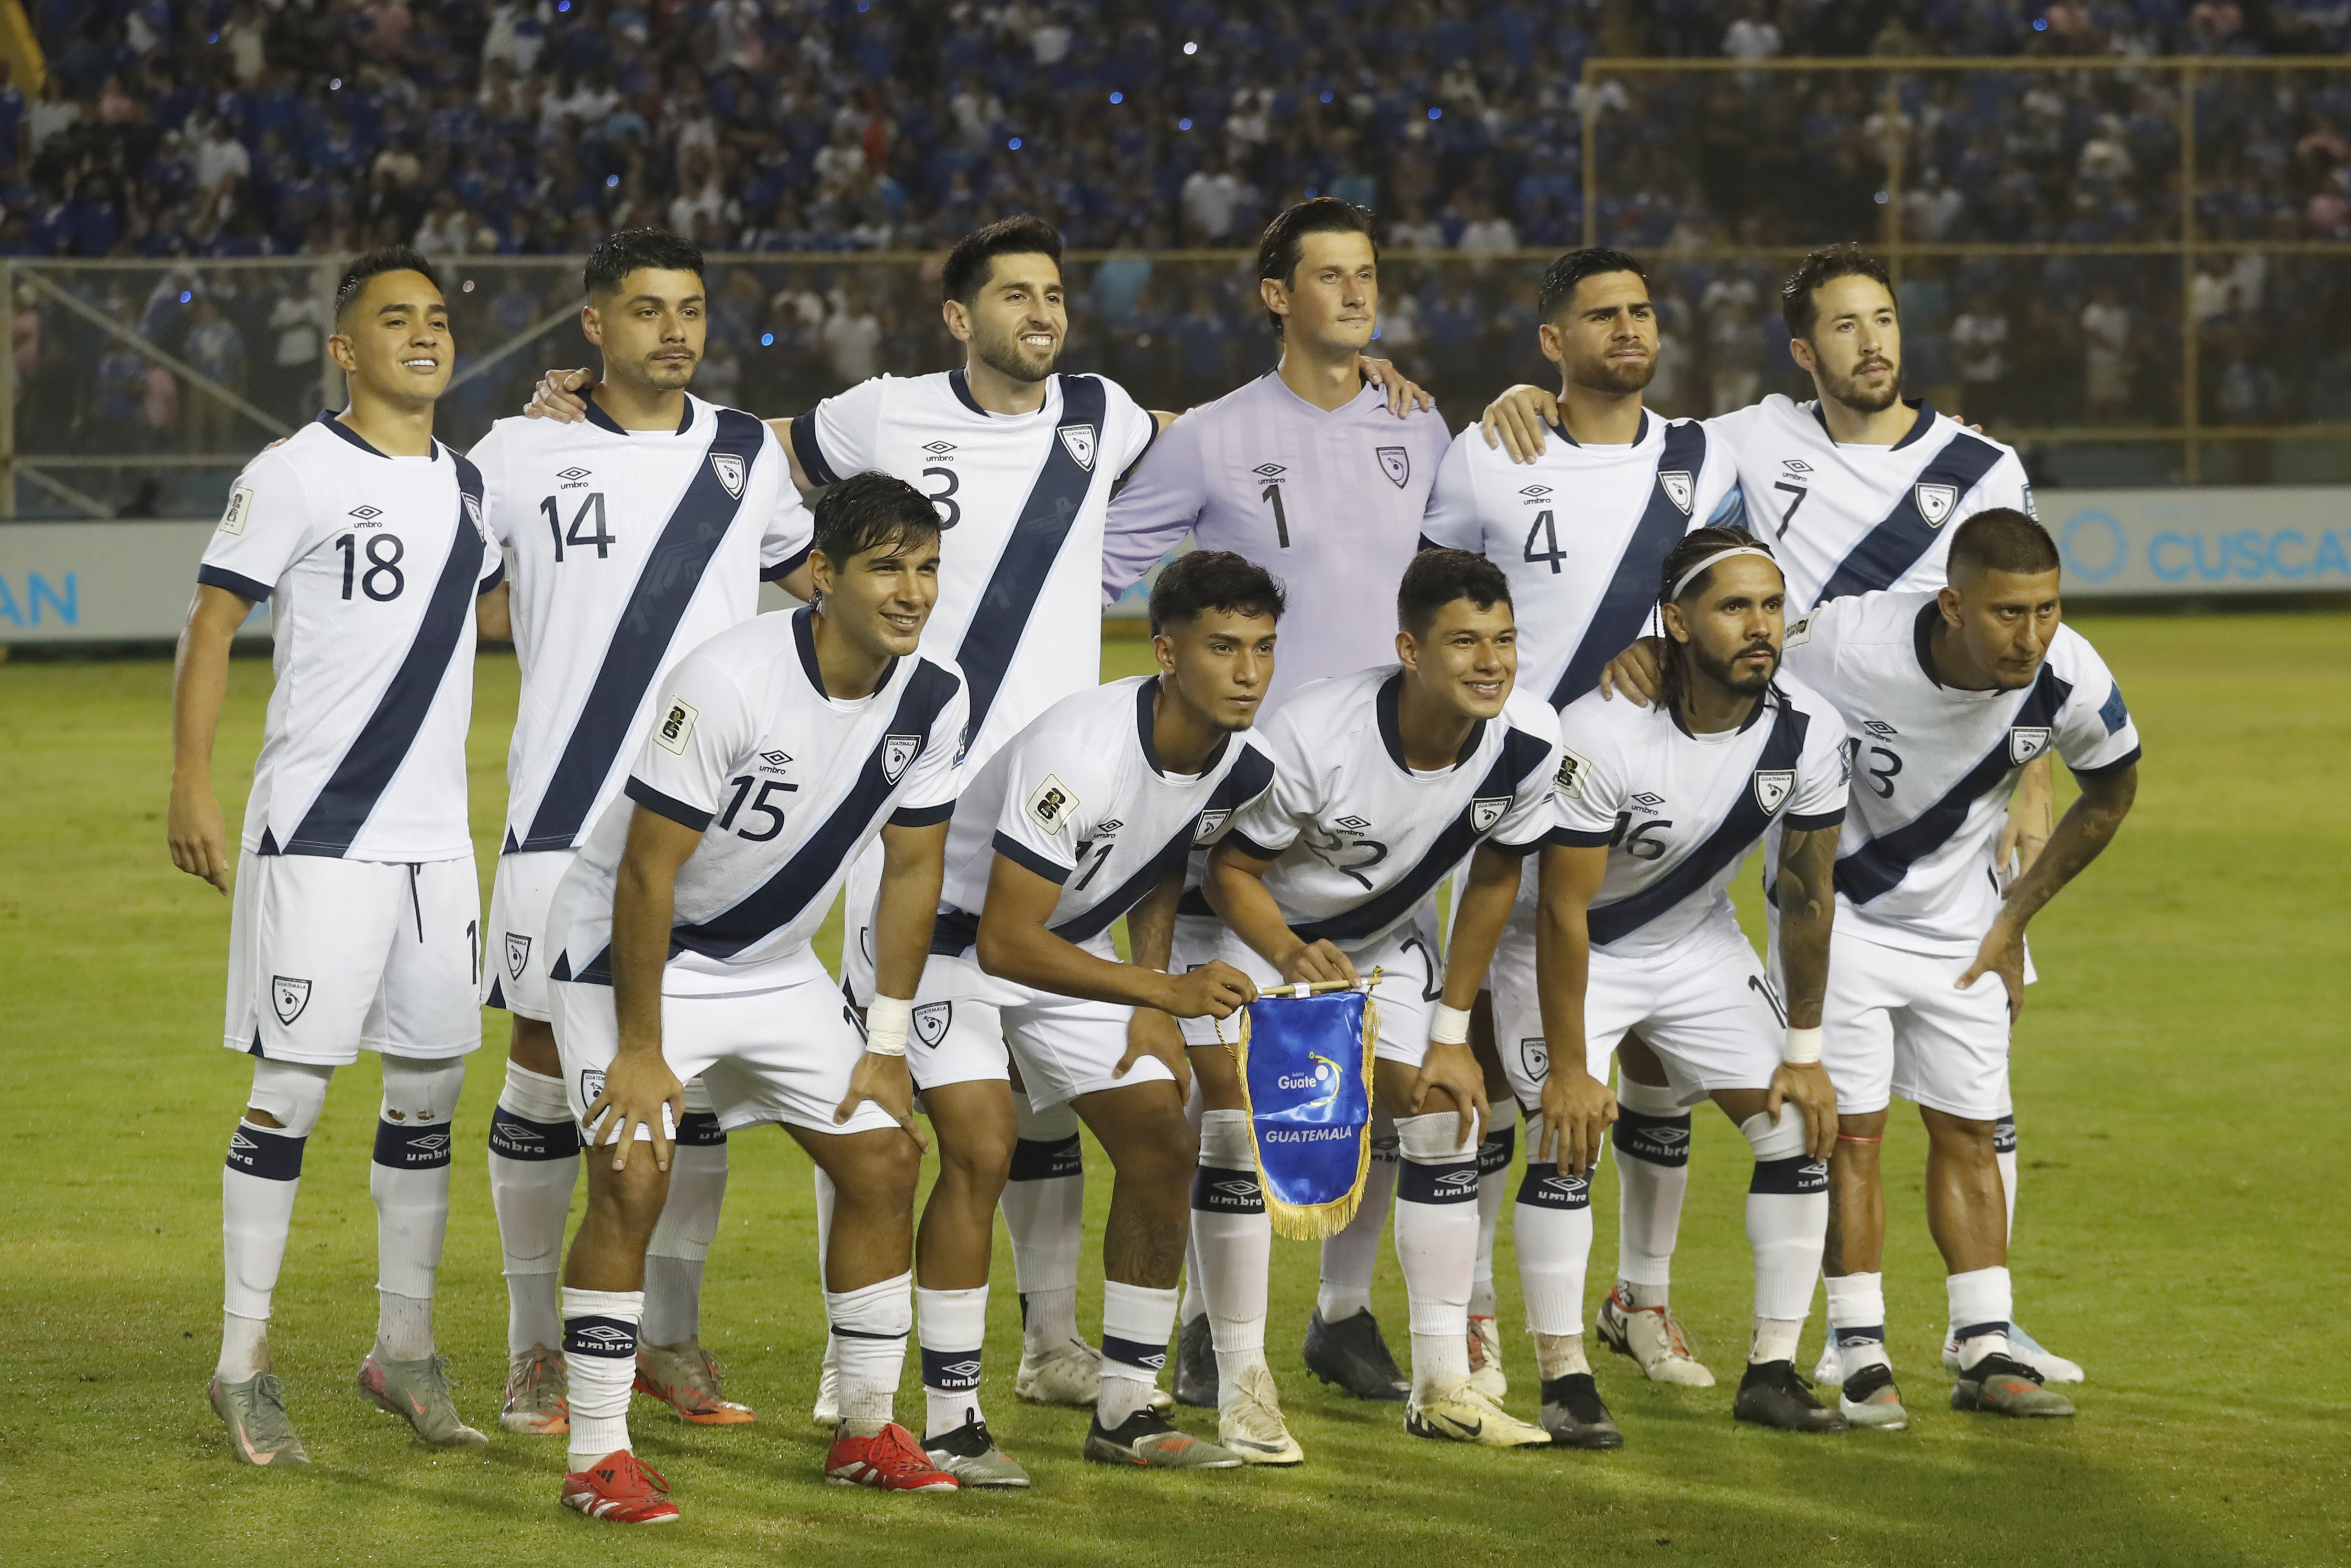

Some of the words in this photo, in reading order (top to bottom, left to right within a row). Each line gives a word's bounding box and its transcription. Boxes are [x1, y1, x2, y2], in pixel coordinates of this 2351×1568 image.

[1258, 476, 1285, 485] umbro
[1782, 471, 1807, 483] umbro
[561, 481, 589, 489] umbro
[923, 467, 960, 531] 3
[1523, 497, 1551, 505] umbro
[1262, 484, 1289, 548] 1
[1774, 481, 1807, 542] 7
[354, 521, 383, 529] umbro
[540, 493, 616, 562] 14
[1523, 510, 1567, 574] 4
[2148, 528, 2351, 582] CUSCA
[336, 533, 404, 602] 18
[1865, 729, 1892, 743] umbro
[760, 765, 786, 775] umbro
[719, 775, 798, 842] 15
[1631, 804, 1658, 816] umbro
[1336, 829, 1365, 837] umbro
[1609, 812, 1673, 861] 16
[277, 981, 306, 989] GUATEMALA
[1748, 975, 1787, 1029] 1
[917, 1006, 947, 1016] GUATEMALA
[844, 1005, 868, 1046] 1
[1278, 1075, 1317, 1090] Guate
[1265, 1125, 1352, 1143] GUATEMALA
[493, 1134, 545, 1153] umbro
[228, 1148, 254, 1165] bro
[1476, 1154, 1505, 1167] bro
[1433, 1184, 1478, 1197] umbr
[1538, 1191, 1587, 1202] umbro
[1209, 1195, 1263, 1206] umbro
[577, 1340, 633, 1351] umbro
